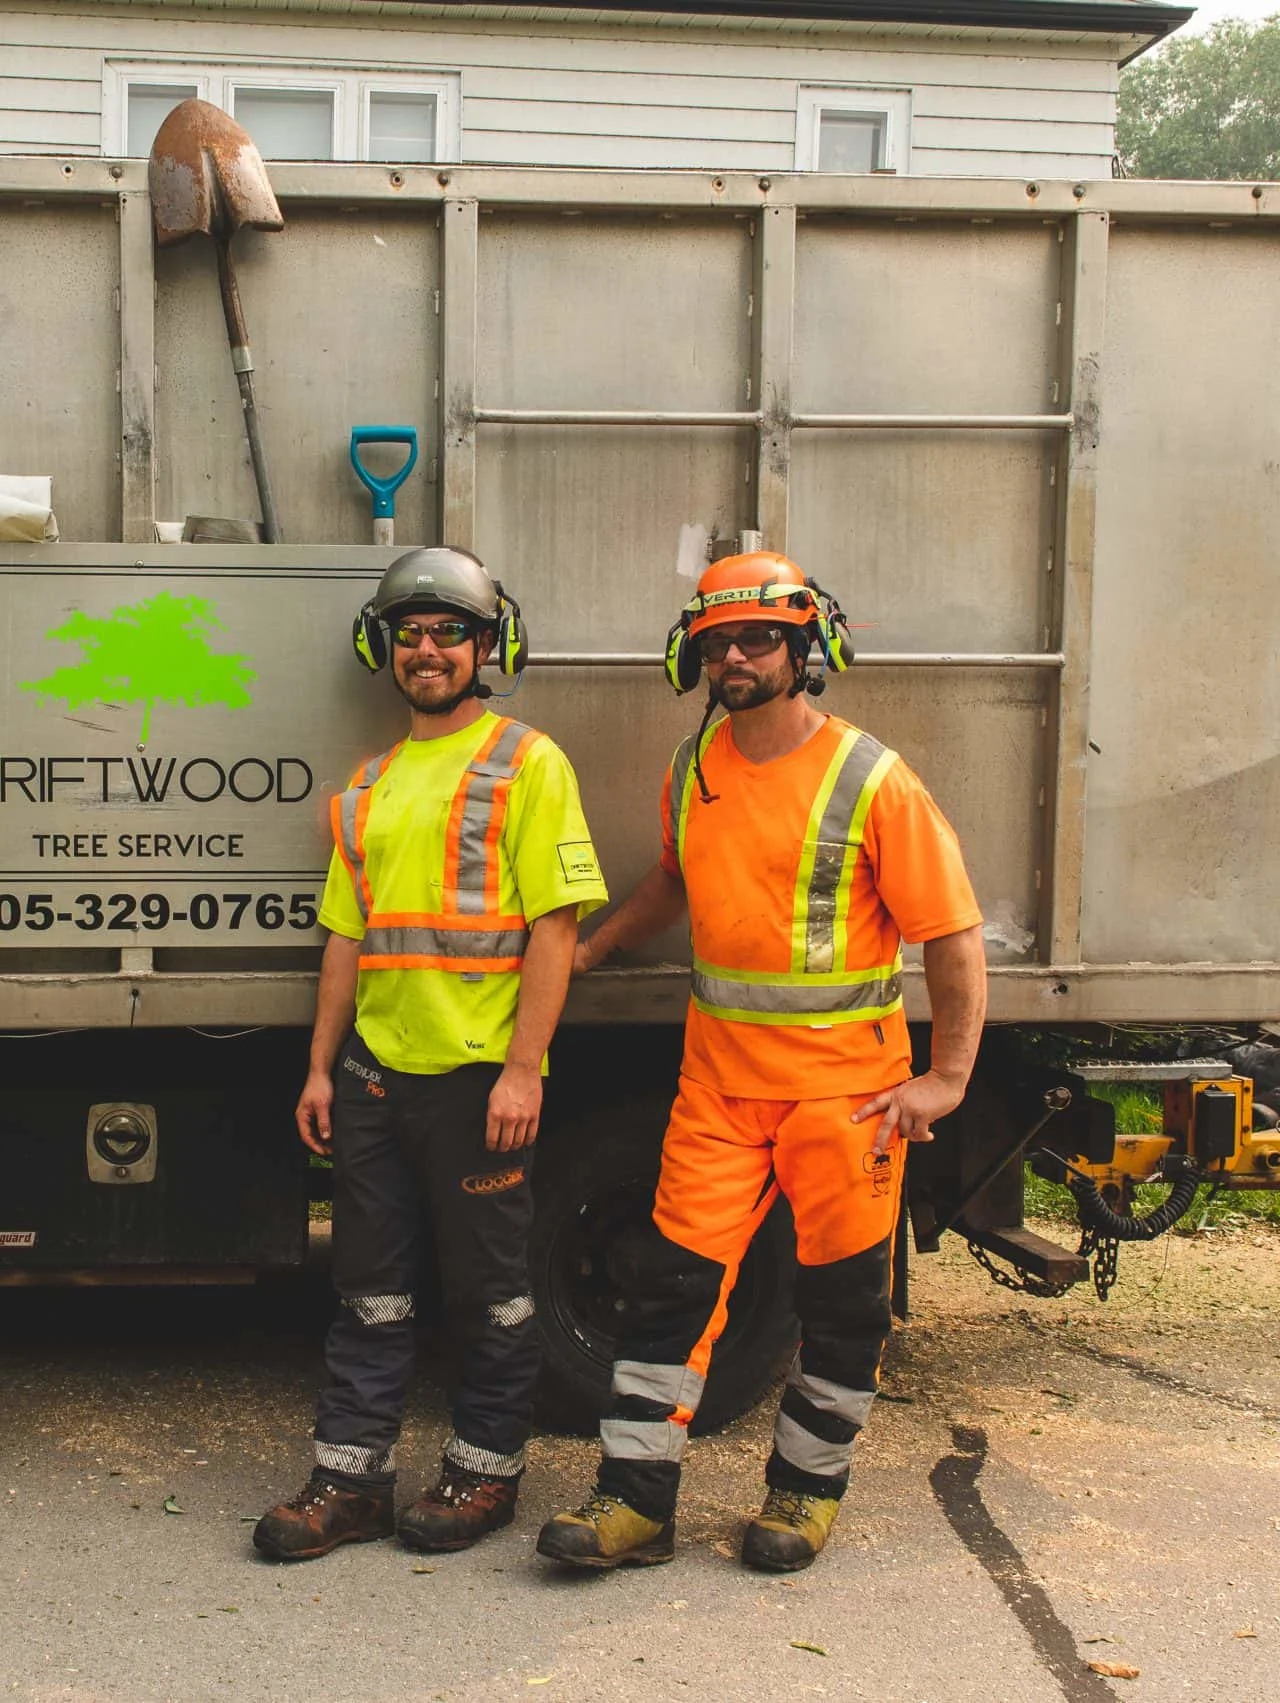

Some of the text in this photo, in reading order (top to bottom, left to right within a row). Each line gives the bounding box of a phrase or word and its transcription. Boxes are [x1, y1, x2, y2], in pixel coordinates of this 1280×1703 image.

[32, 834, 244, 857] TREE SERVICE
[0, 1232, 32, 1245] guard
